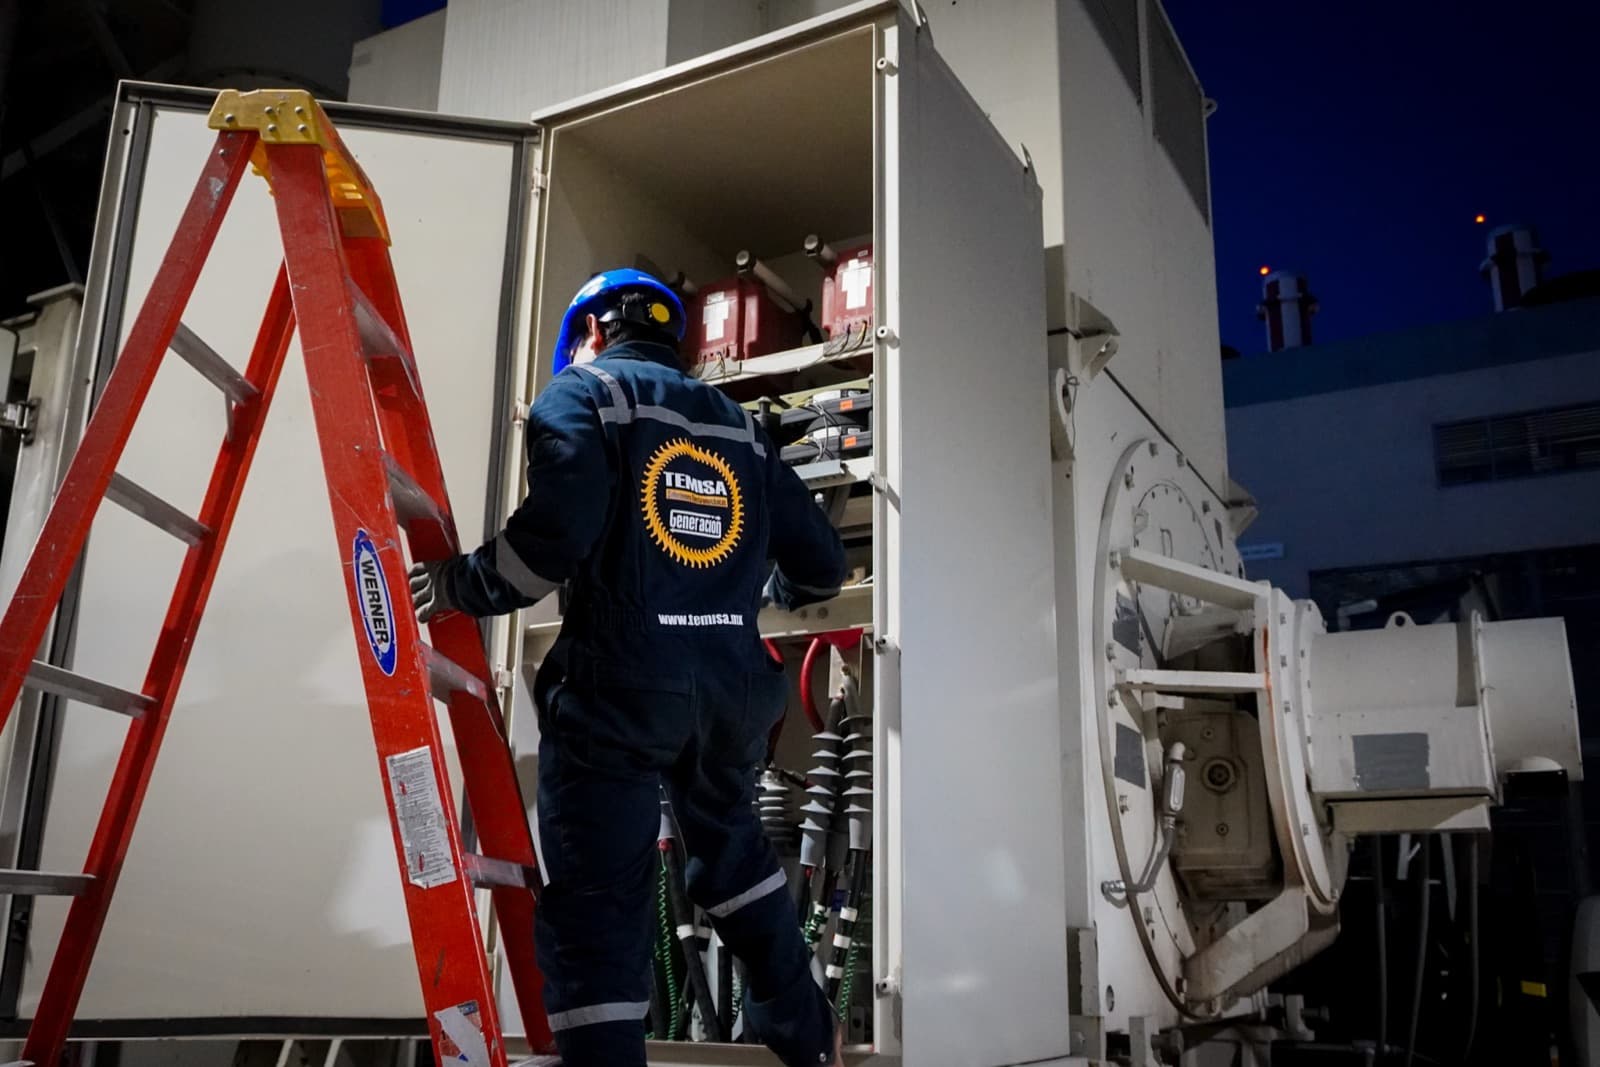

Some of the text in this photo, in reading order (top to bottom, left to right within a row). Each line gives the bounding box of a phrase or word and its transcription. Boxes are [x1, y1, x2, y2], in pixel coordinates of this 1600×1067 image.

[663, 471, 728, 496] TEMISA
[670, 510, 721, 536] Generación
[361, 559, 389, 645] WERNER
[657, 613, 743, 626] www.temisa.mx
